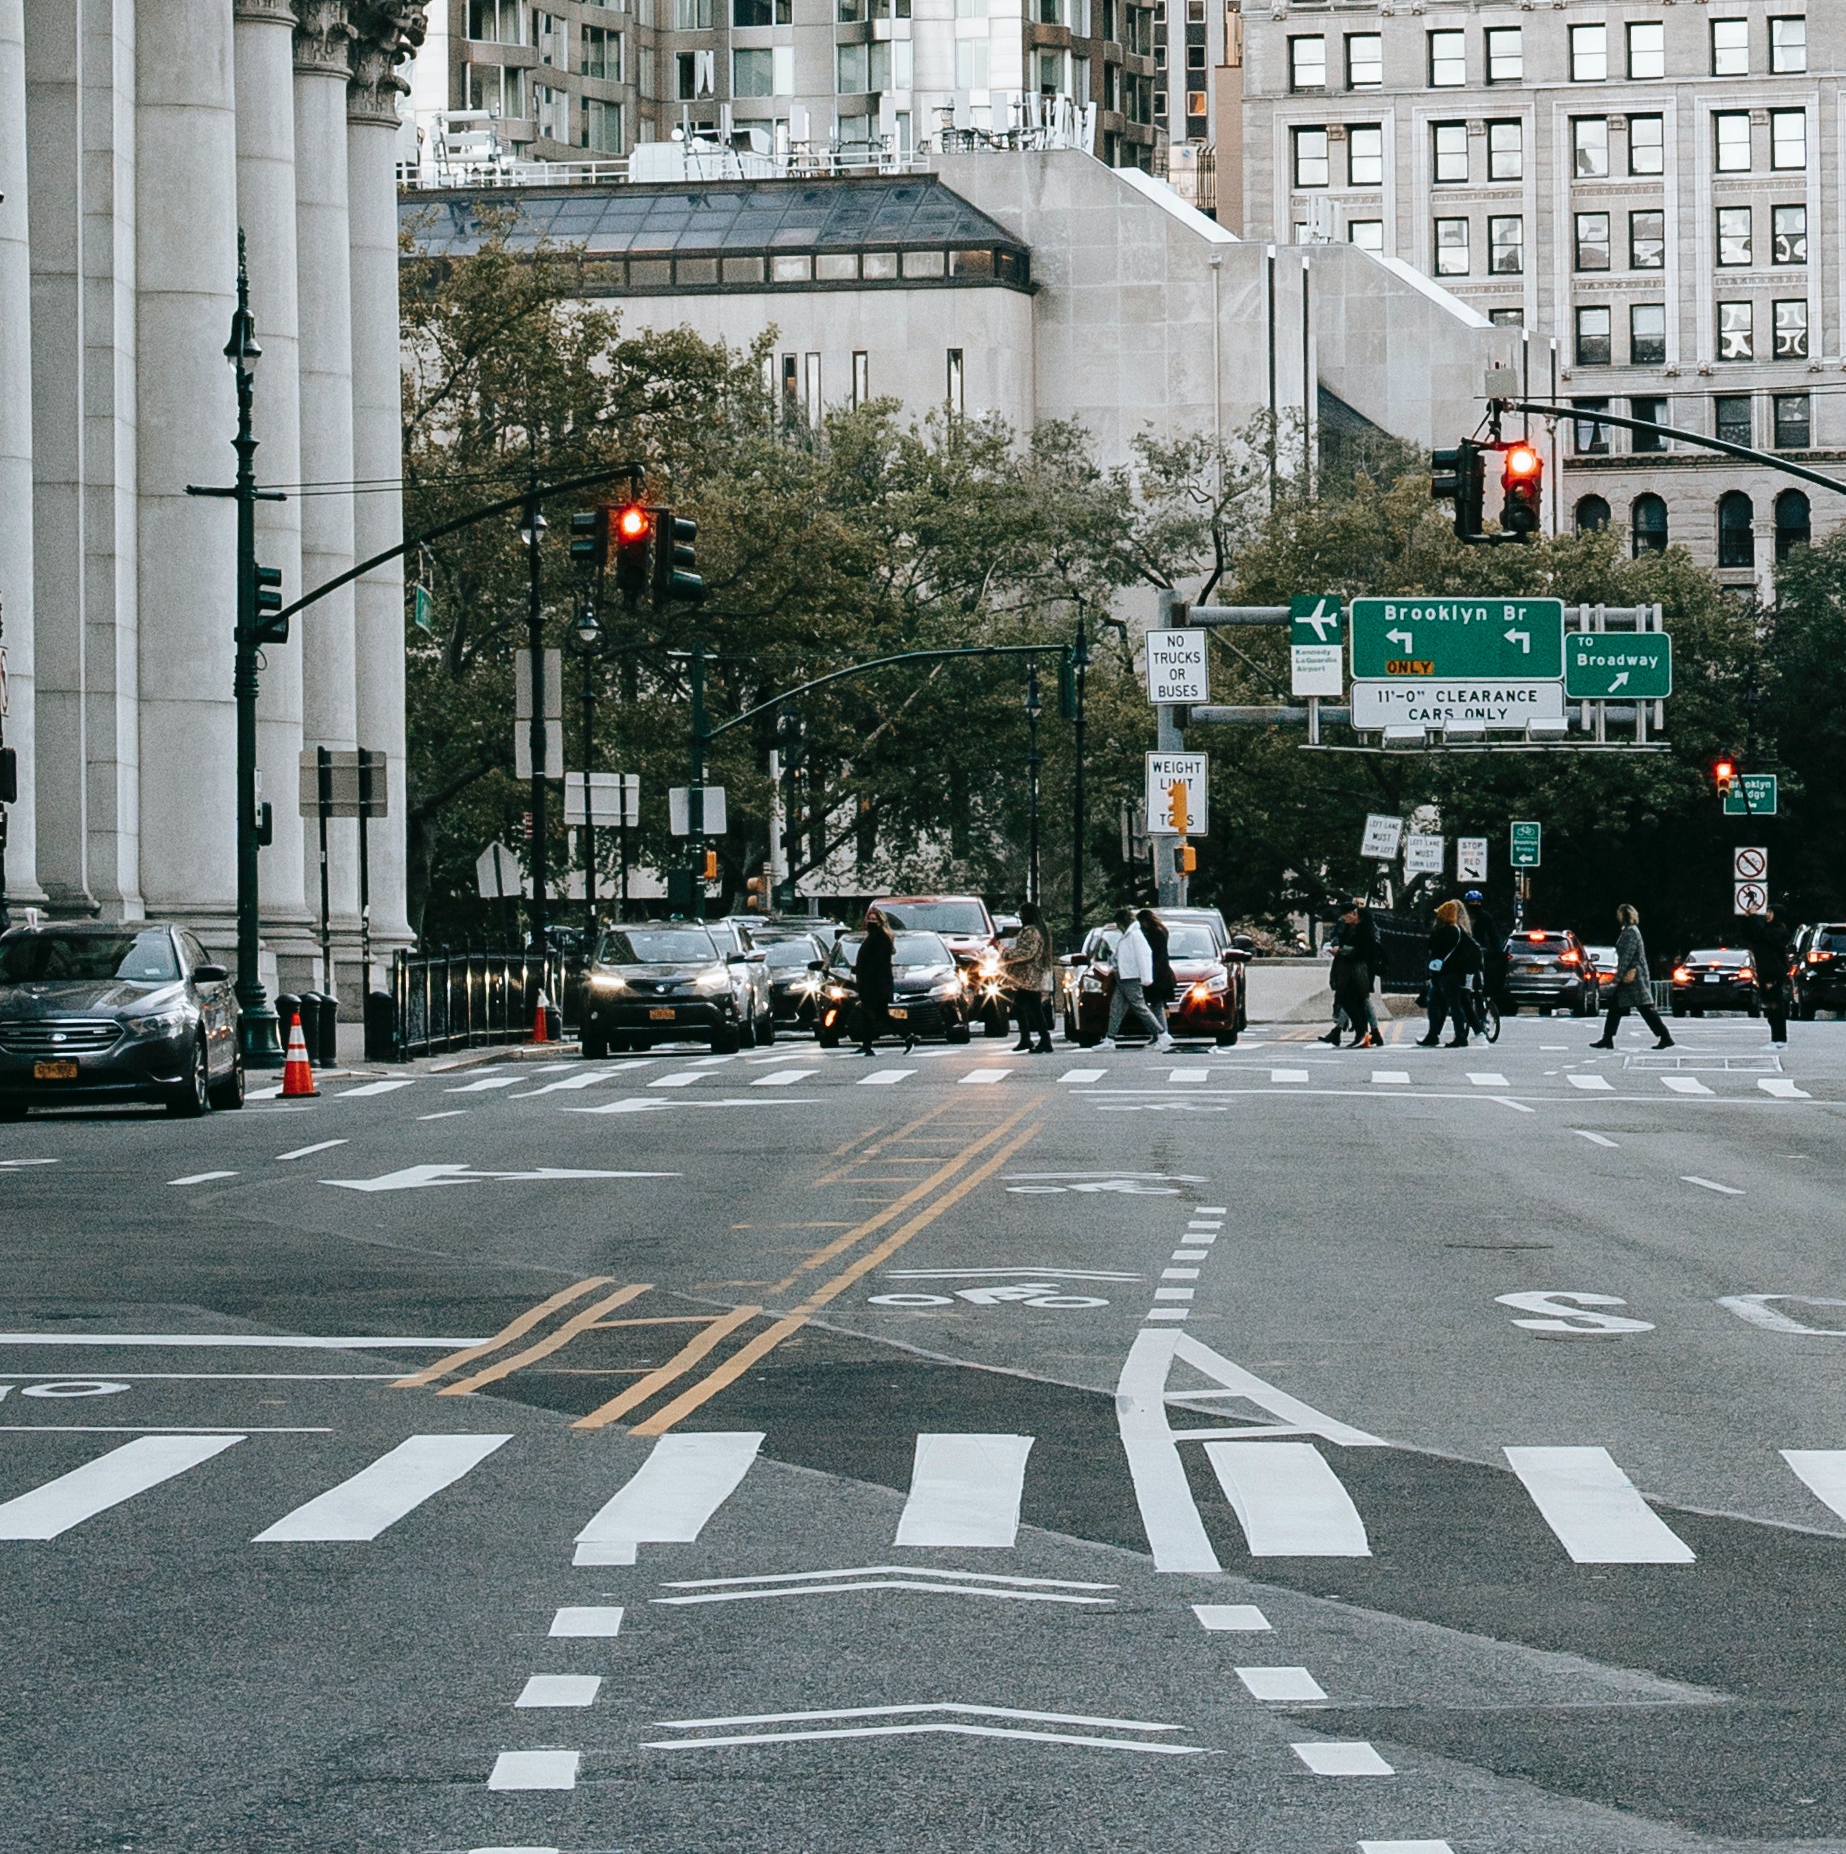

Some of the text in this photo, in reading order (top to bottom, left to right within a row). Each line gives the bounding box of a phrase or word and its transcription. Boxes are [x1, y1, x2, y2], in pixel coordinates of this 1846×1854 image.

[1385, 605, 1527, 624] Brooklyn Br
[1167, 635, 1184, 647] NO
[1577, 637, 1594, 647] TO
[1153, 651, 1201, 664] TRUCKS
[1577, 653, 1658, 669] Broadway
[1297, 665, 1326, 673] Airport
[1387, 661, 1433, 674] ONLY
[1169, 668, 1185, 681] OR
[1158, 685, 1198, 698] BUSES
[1436, 690, 1537, 702] CLEARANCE
[1409, 708, 1508, 720] CARS ONLY
[1153, 761, 1201, 774] WEIGHT
[1734, 790, 1765, 800] Brdge
[1160, 814, 1194, 826] TOS
[1369, 820, 1399, 830] LEFT LANE
[1372, 833, 1391, 842] MUST
[1410, 838, 1440, 847] LEFT LANE
[1365, 844, 1394, 854] TURN LEFT
